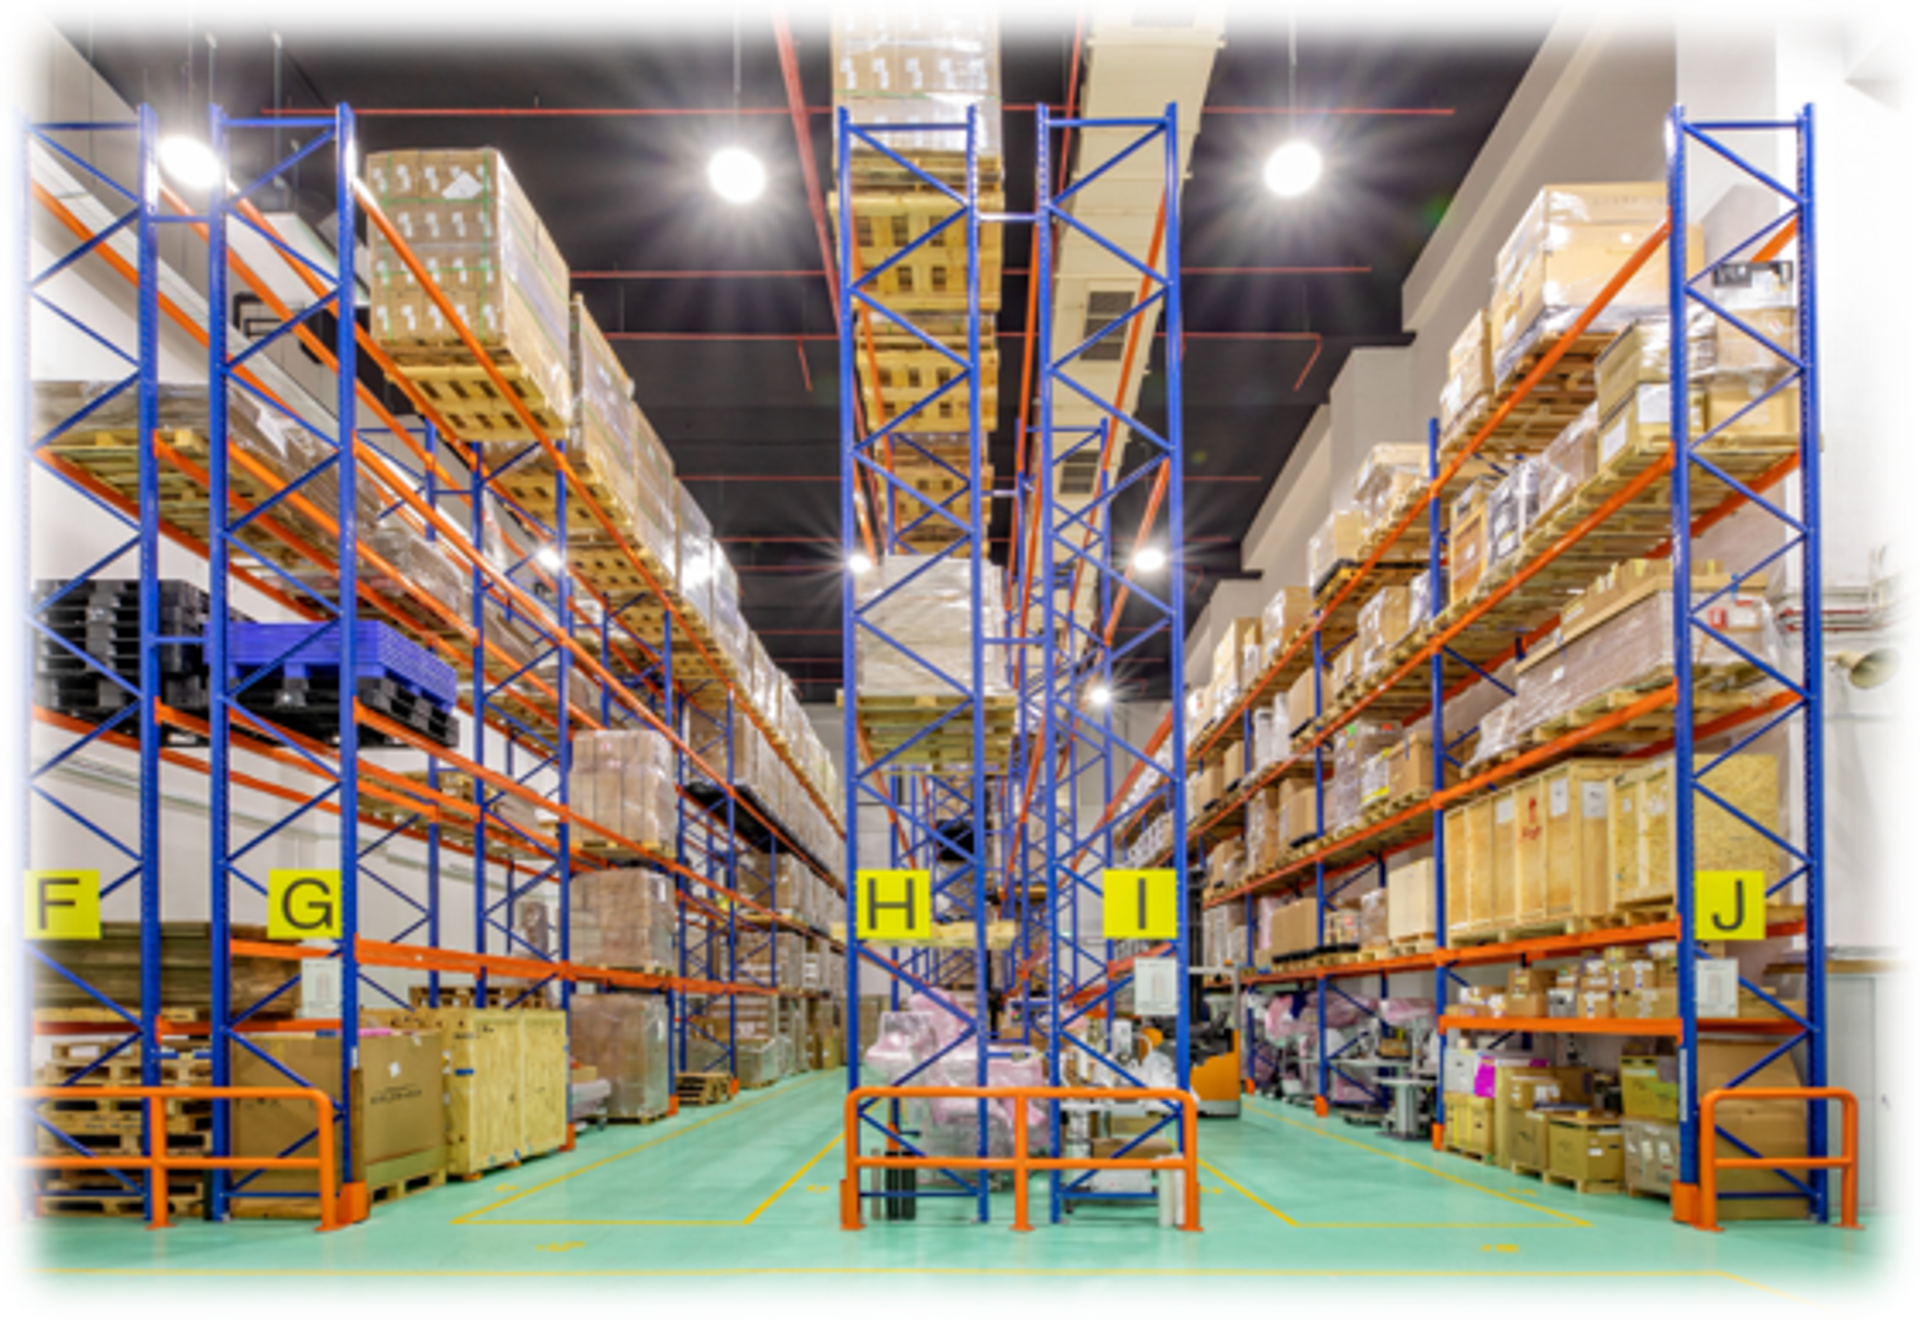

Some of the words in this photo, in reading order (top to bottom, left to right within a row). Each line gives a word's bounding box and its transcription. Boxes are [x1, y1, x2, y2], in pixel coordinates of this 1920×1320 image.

[37, 878, 79, 930] F
[281, 878, 333, 930] G
[868, 879, 914, 930] H
[1711, 880, 1745, 931] J
